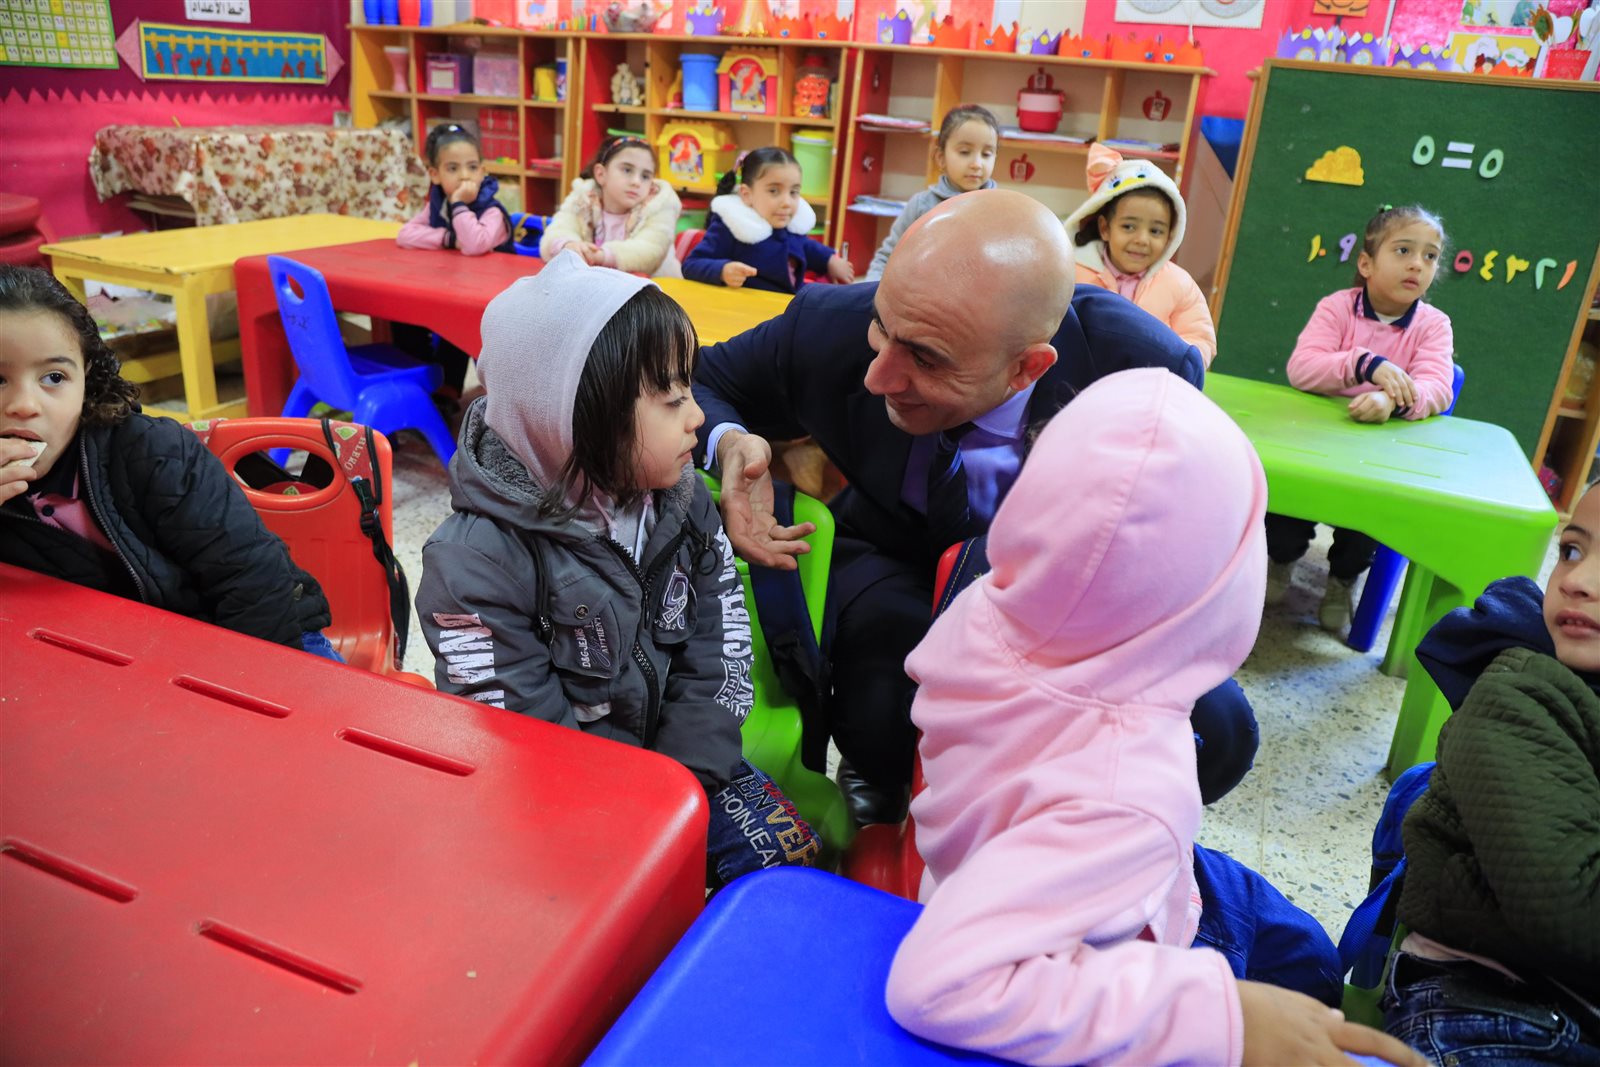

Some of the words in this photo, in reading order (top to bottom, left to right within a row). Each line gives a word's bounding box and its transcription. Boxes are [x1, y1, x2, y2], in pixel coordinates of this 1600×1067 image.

[1339, 233, 1357, 262] ٩
[1480, 250, 1498, 281] ٤
[1506, 254, 1529, 283] ٣
[1535, 257, 1557, 290] ٢
[1557, 260, 1578, 290] ١
